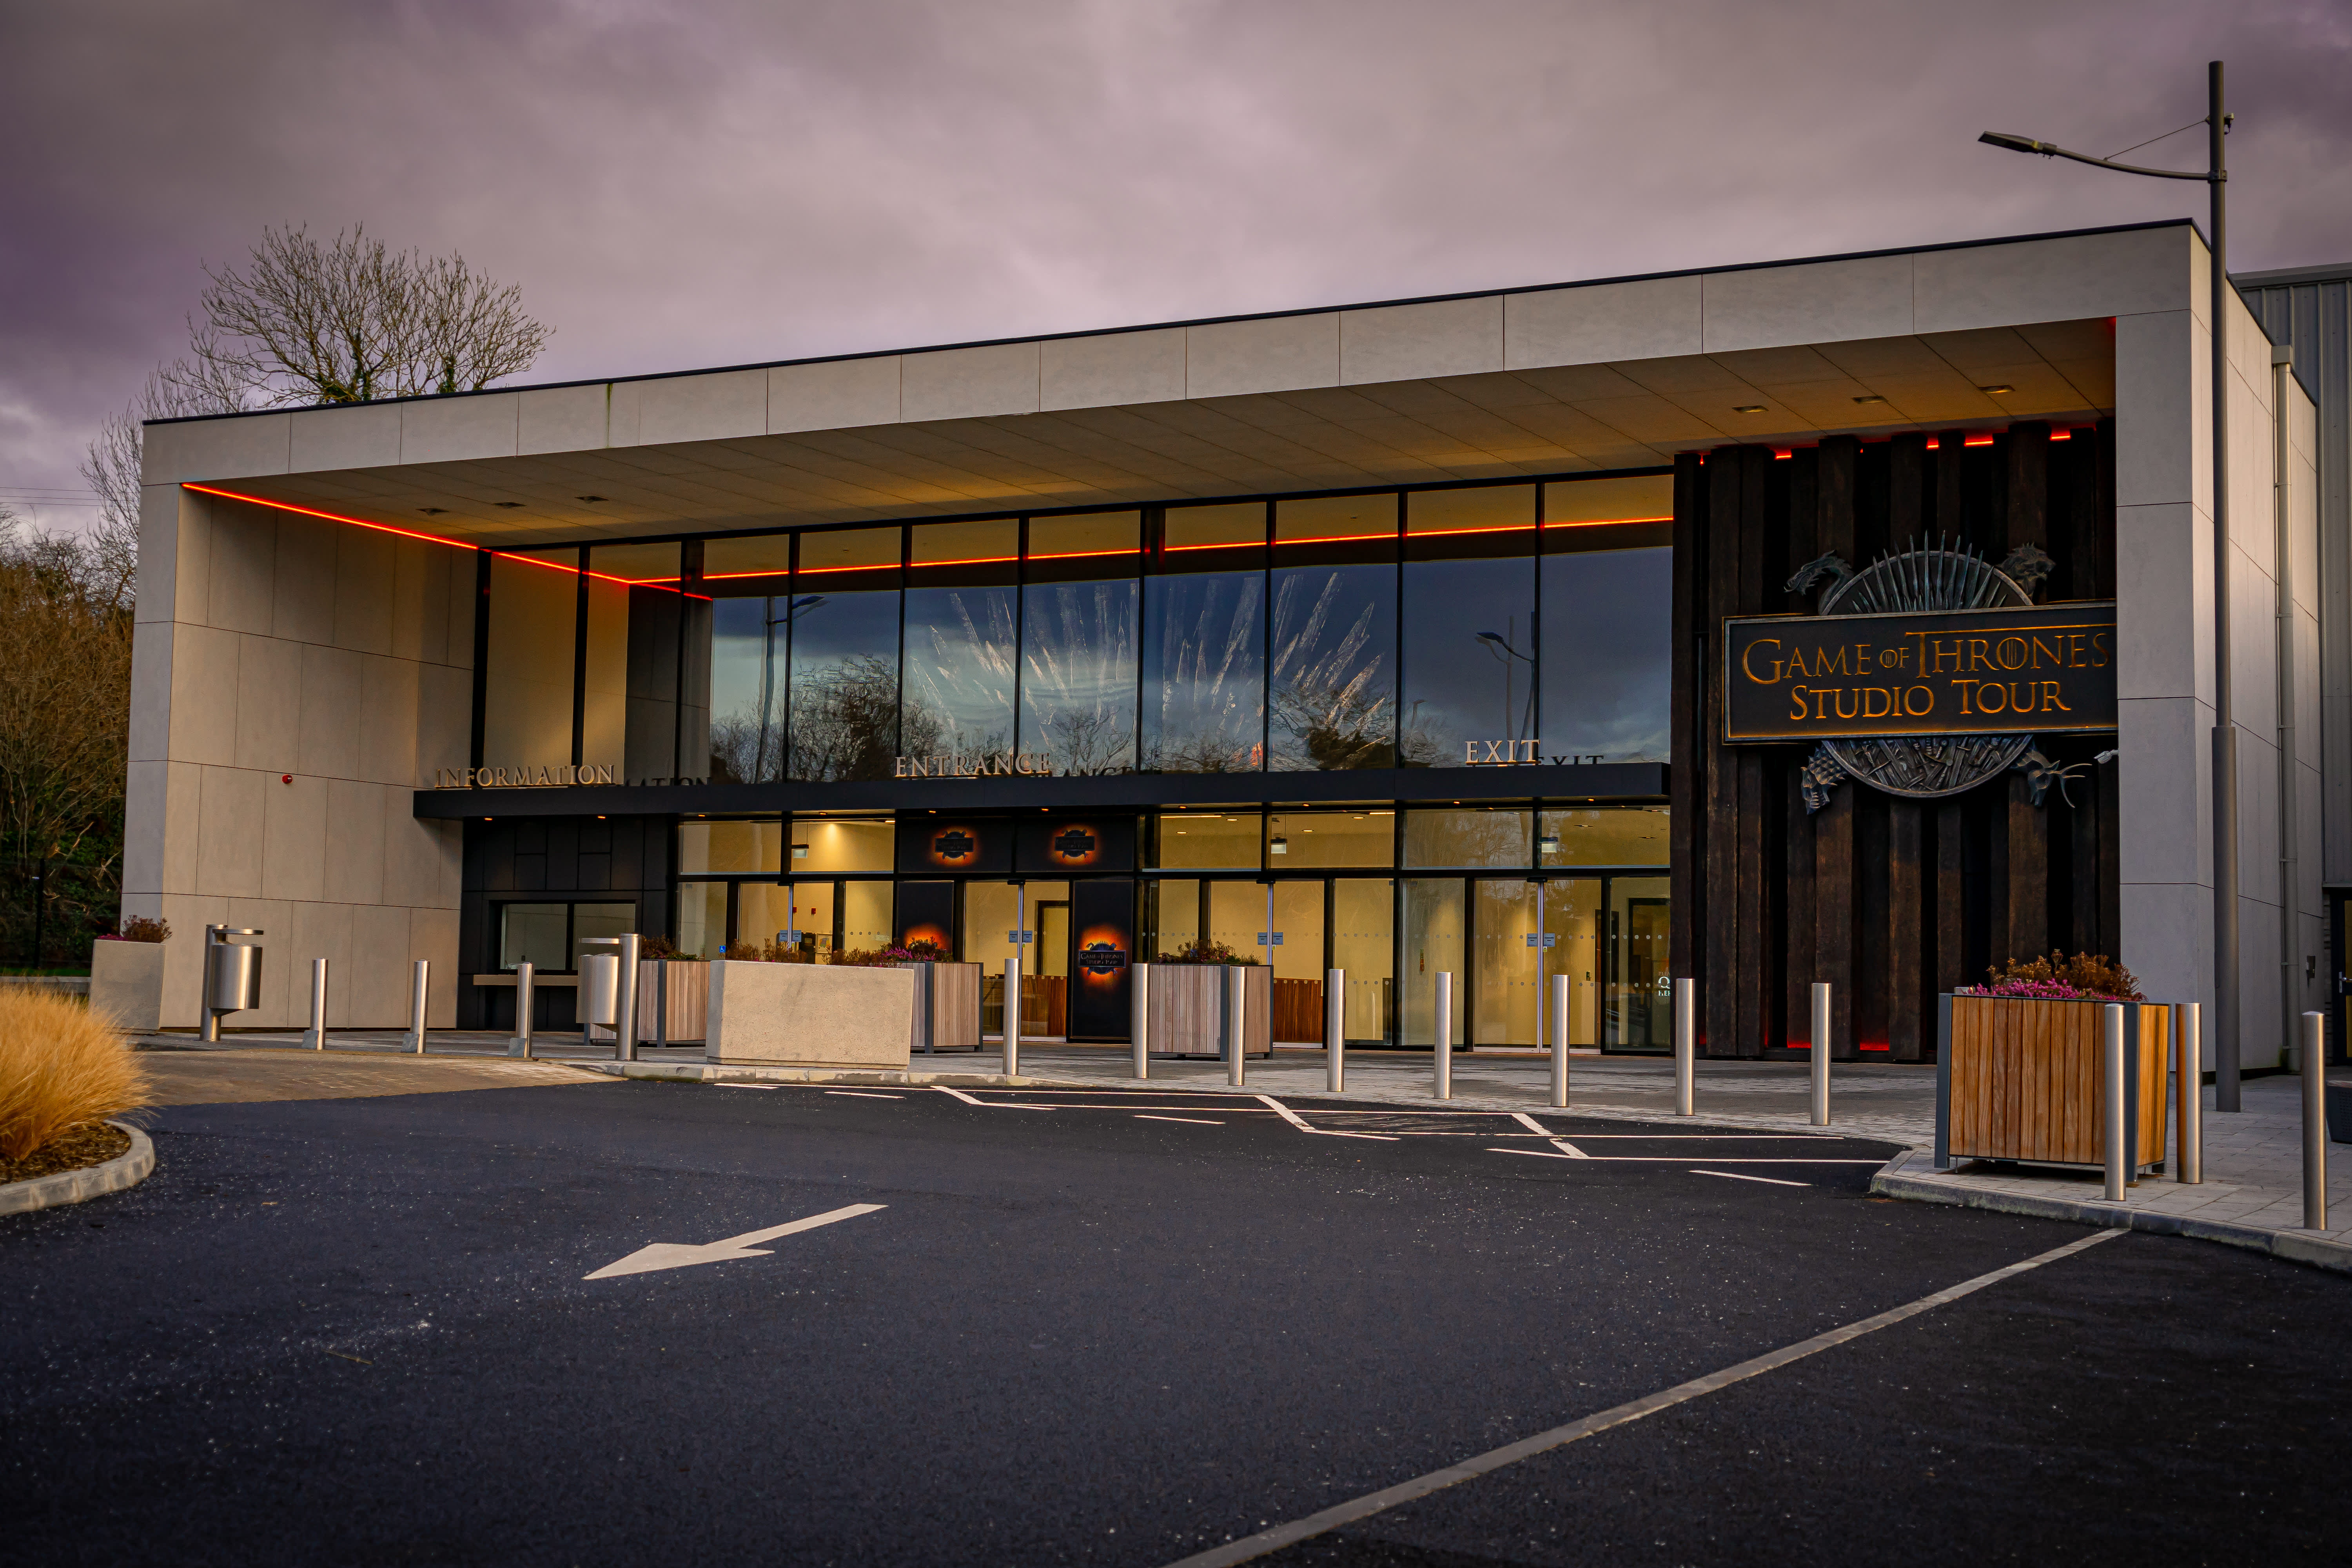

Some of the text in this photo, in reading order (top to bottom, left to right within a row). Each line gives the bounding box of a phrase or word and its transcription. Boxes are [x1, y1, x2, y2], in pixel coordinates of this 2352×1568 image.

[1742, 623, 2116, 684] GAME OF THRONES
[1790, 679, 2072, 720] STUDIO TOUR
[1465, 739, 1540, 763] EXIT
[435, 764, 615, 787] INFORMATION
[895, 753, 1050, 777] ENTRANCE
